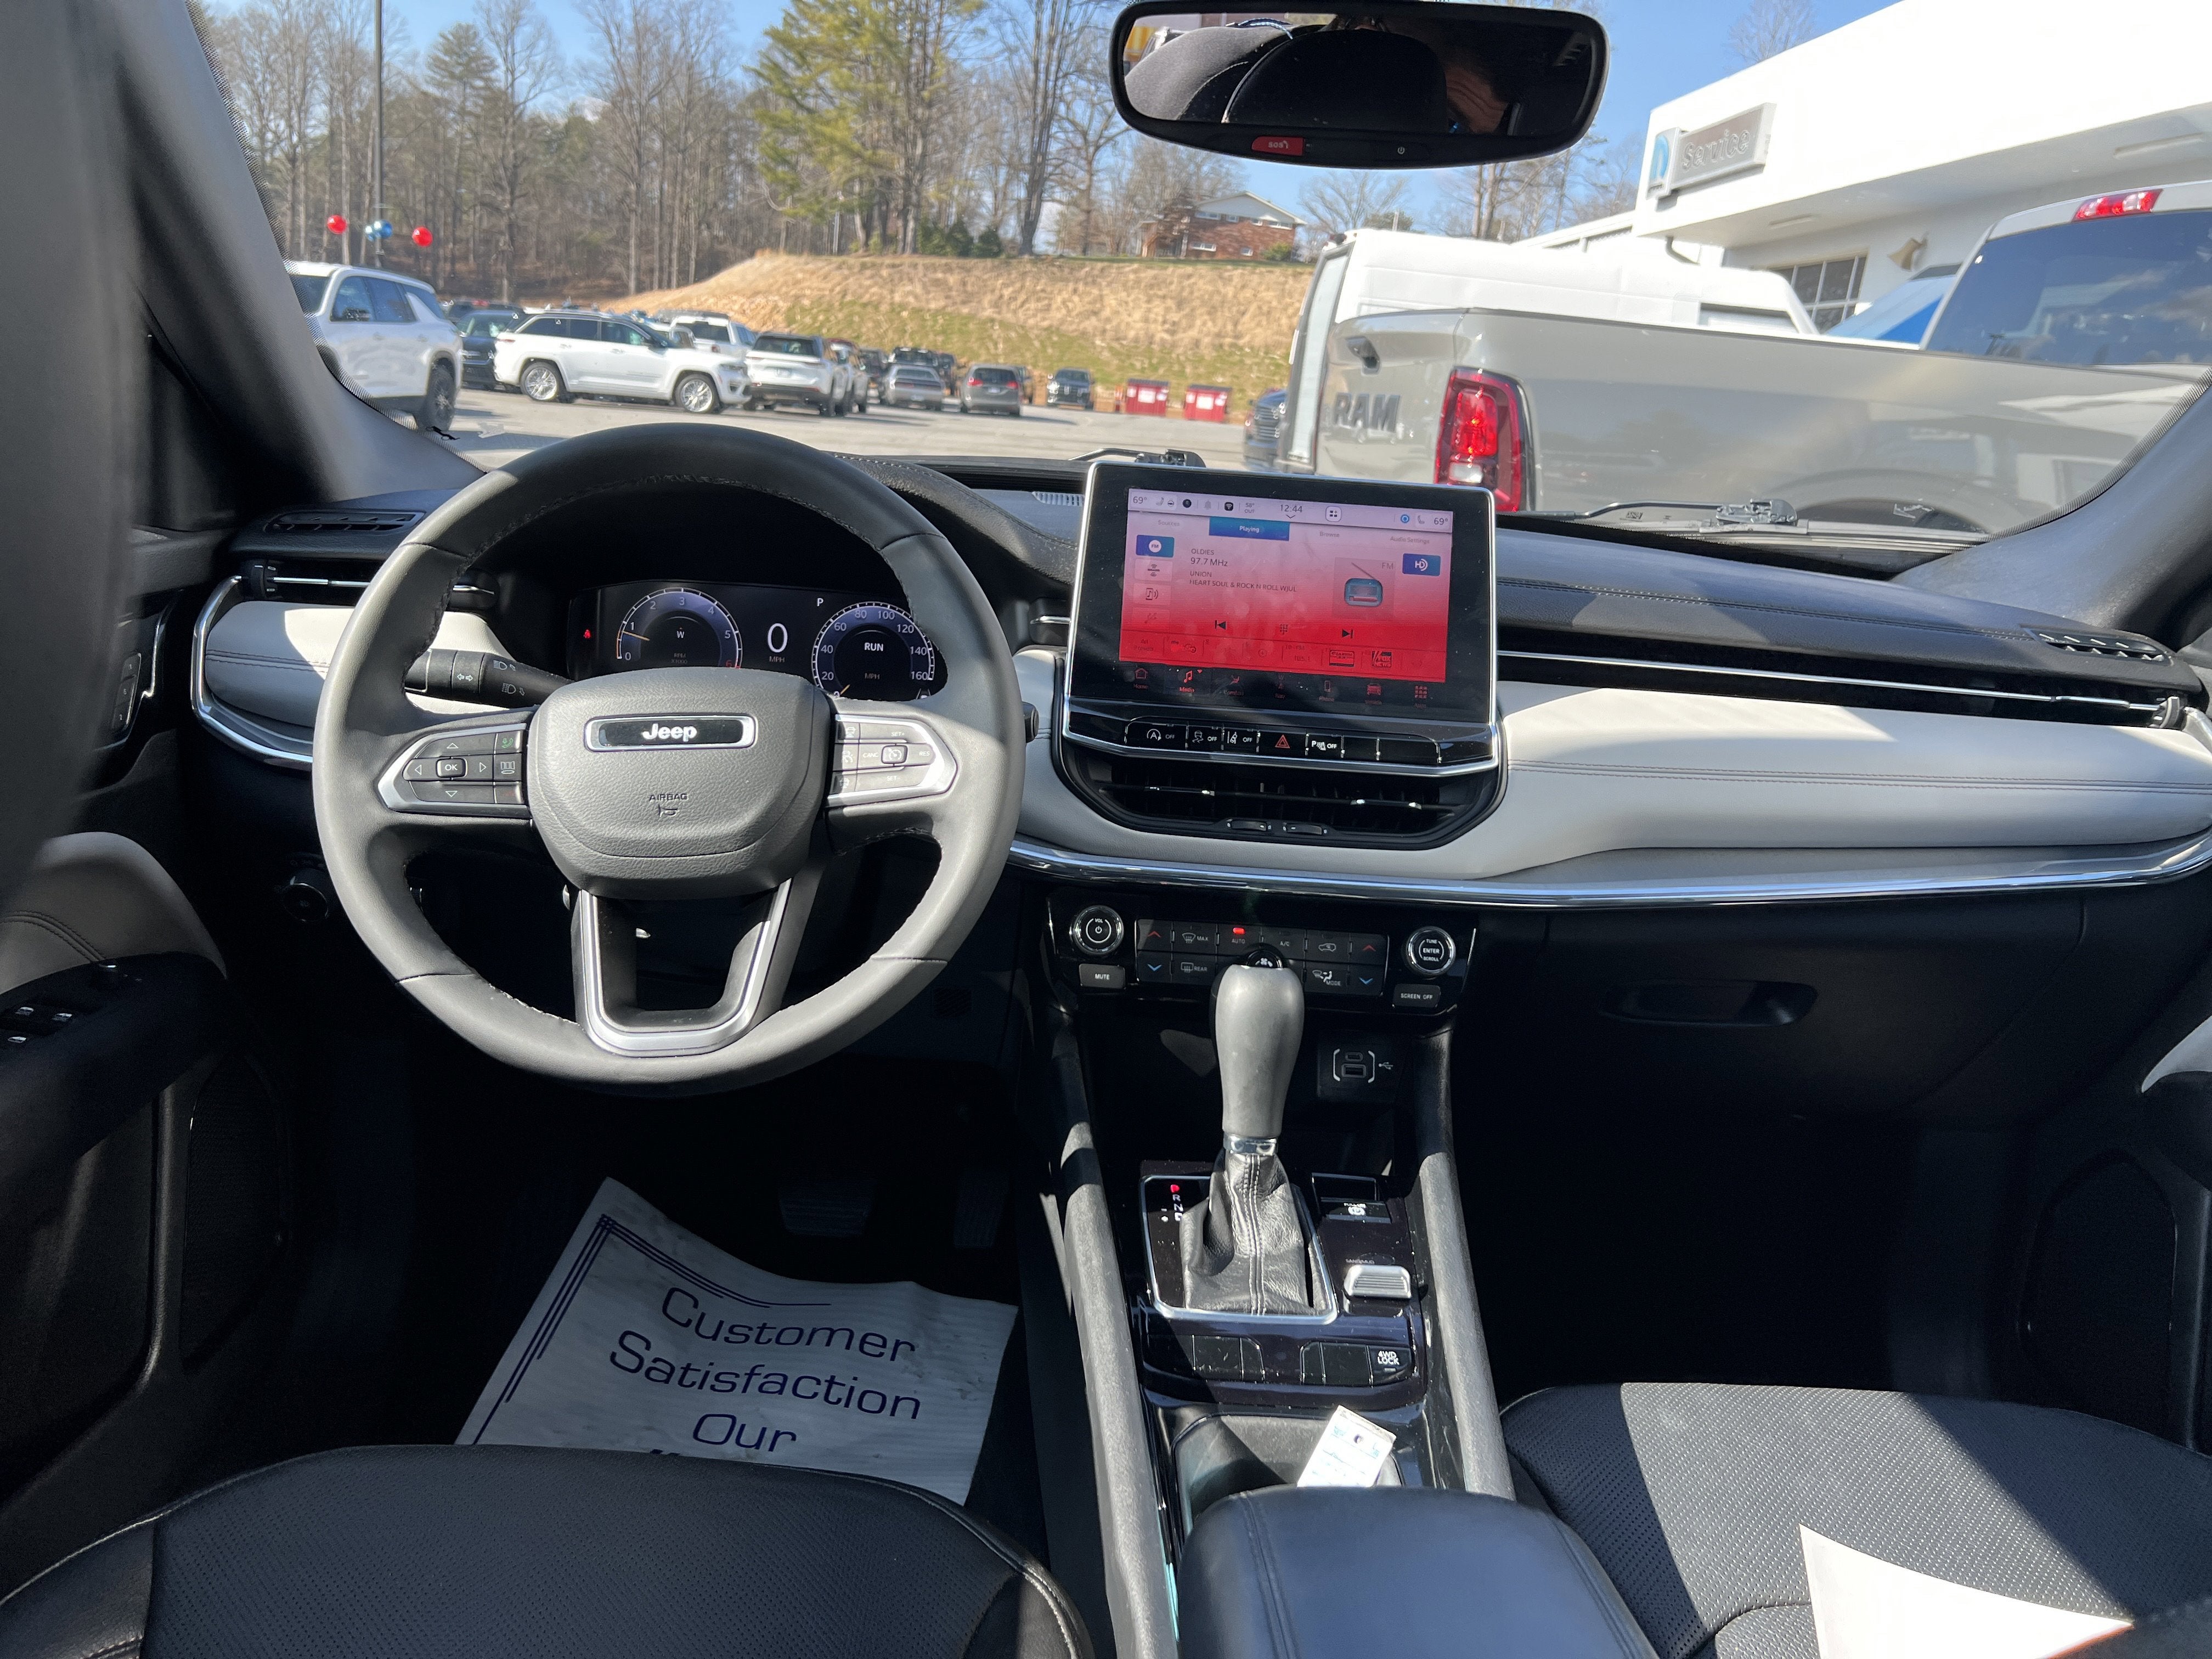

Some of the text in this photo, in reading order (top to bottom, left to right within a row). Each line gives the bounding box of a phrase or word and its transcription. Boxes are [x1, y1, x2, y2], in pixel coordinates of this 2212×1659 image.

[1682, 129, 1750, 172] Service
[1334, 392, 1401, 432] RAM
[1280, 504, 1302, 513] 12:44
[1210, 558, 1228, 567] MHz
[650, 601, 656, 610] 2
[679, 597, 685, 606] 3
[817, 597, 824, 606] P
[854, 610, 867, 619] 80
[878, 611, 895, 620] 100
[630, 622, 635, 630] 1
[834, 622, 847, 631] 60
[897, 624, 915, 634] 120
[724, 630, 731, 639] 5
[768, 623, 788, 653] 0
[821, 645, 834, 654] 40
[864, 642, 884, 652] RUN
[910, 646, 927, 656] 140
[625, 652, 631, 661] 0
[822, 672, 834, 681] 20
[911, 671, 928, 680] 160
[641, 723, 698, 742] Jeep
[649, 793, 689, 802] AIRBAG
[1172, 1194, 1181, 1202] R
[1174, 1203, 1184, 1212] N
[662, 1287, 916, 1362] Customer
[1377, 1357, 1400, 1365] LOCK
[610, 1330, 921, 1419] Satisfaction
[692, 1413, 797, 1452] Our
